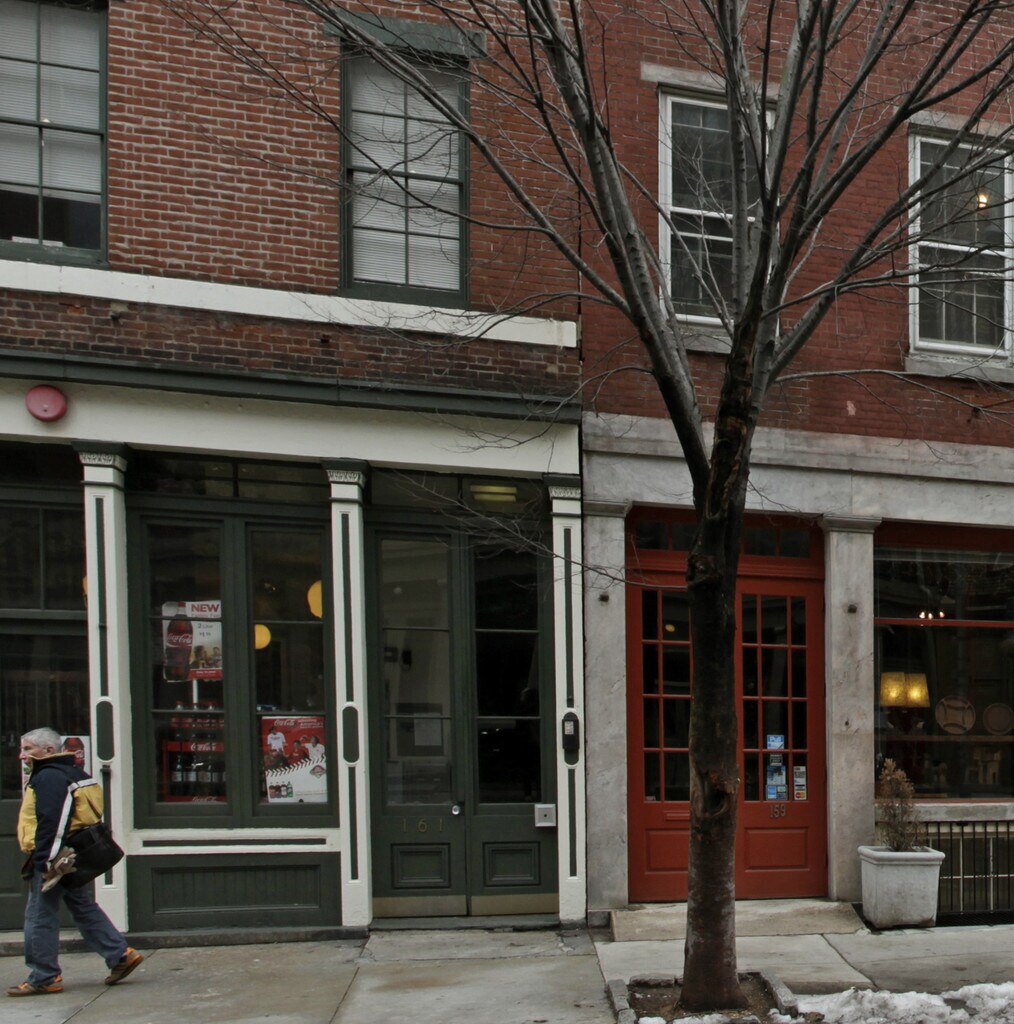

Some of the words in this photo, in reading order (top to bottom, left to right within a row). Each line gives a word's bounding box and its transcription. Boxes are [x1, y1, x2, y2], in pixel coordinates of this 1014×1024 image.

[191, 604, 220, 613] NEW
[769, 804, 786, 818] 159
[402, 818, 443, 833] 161
